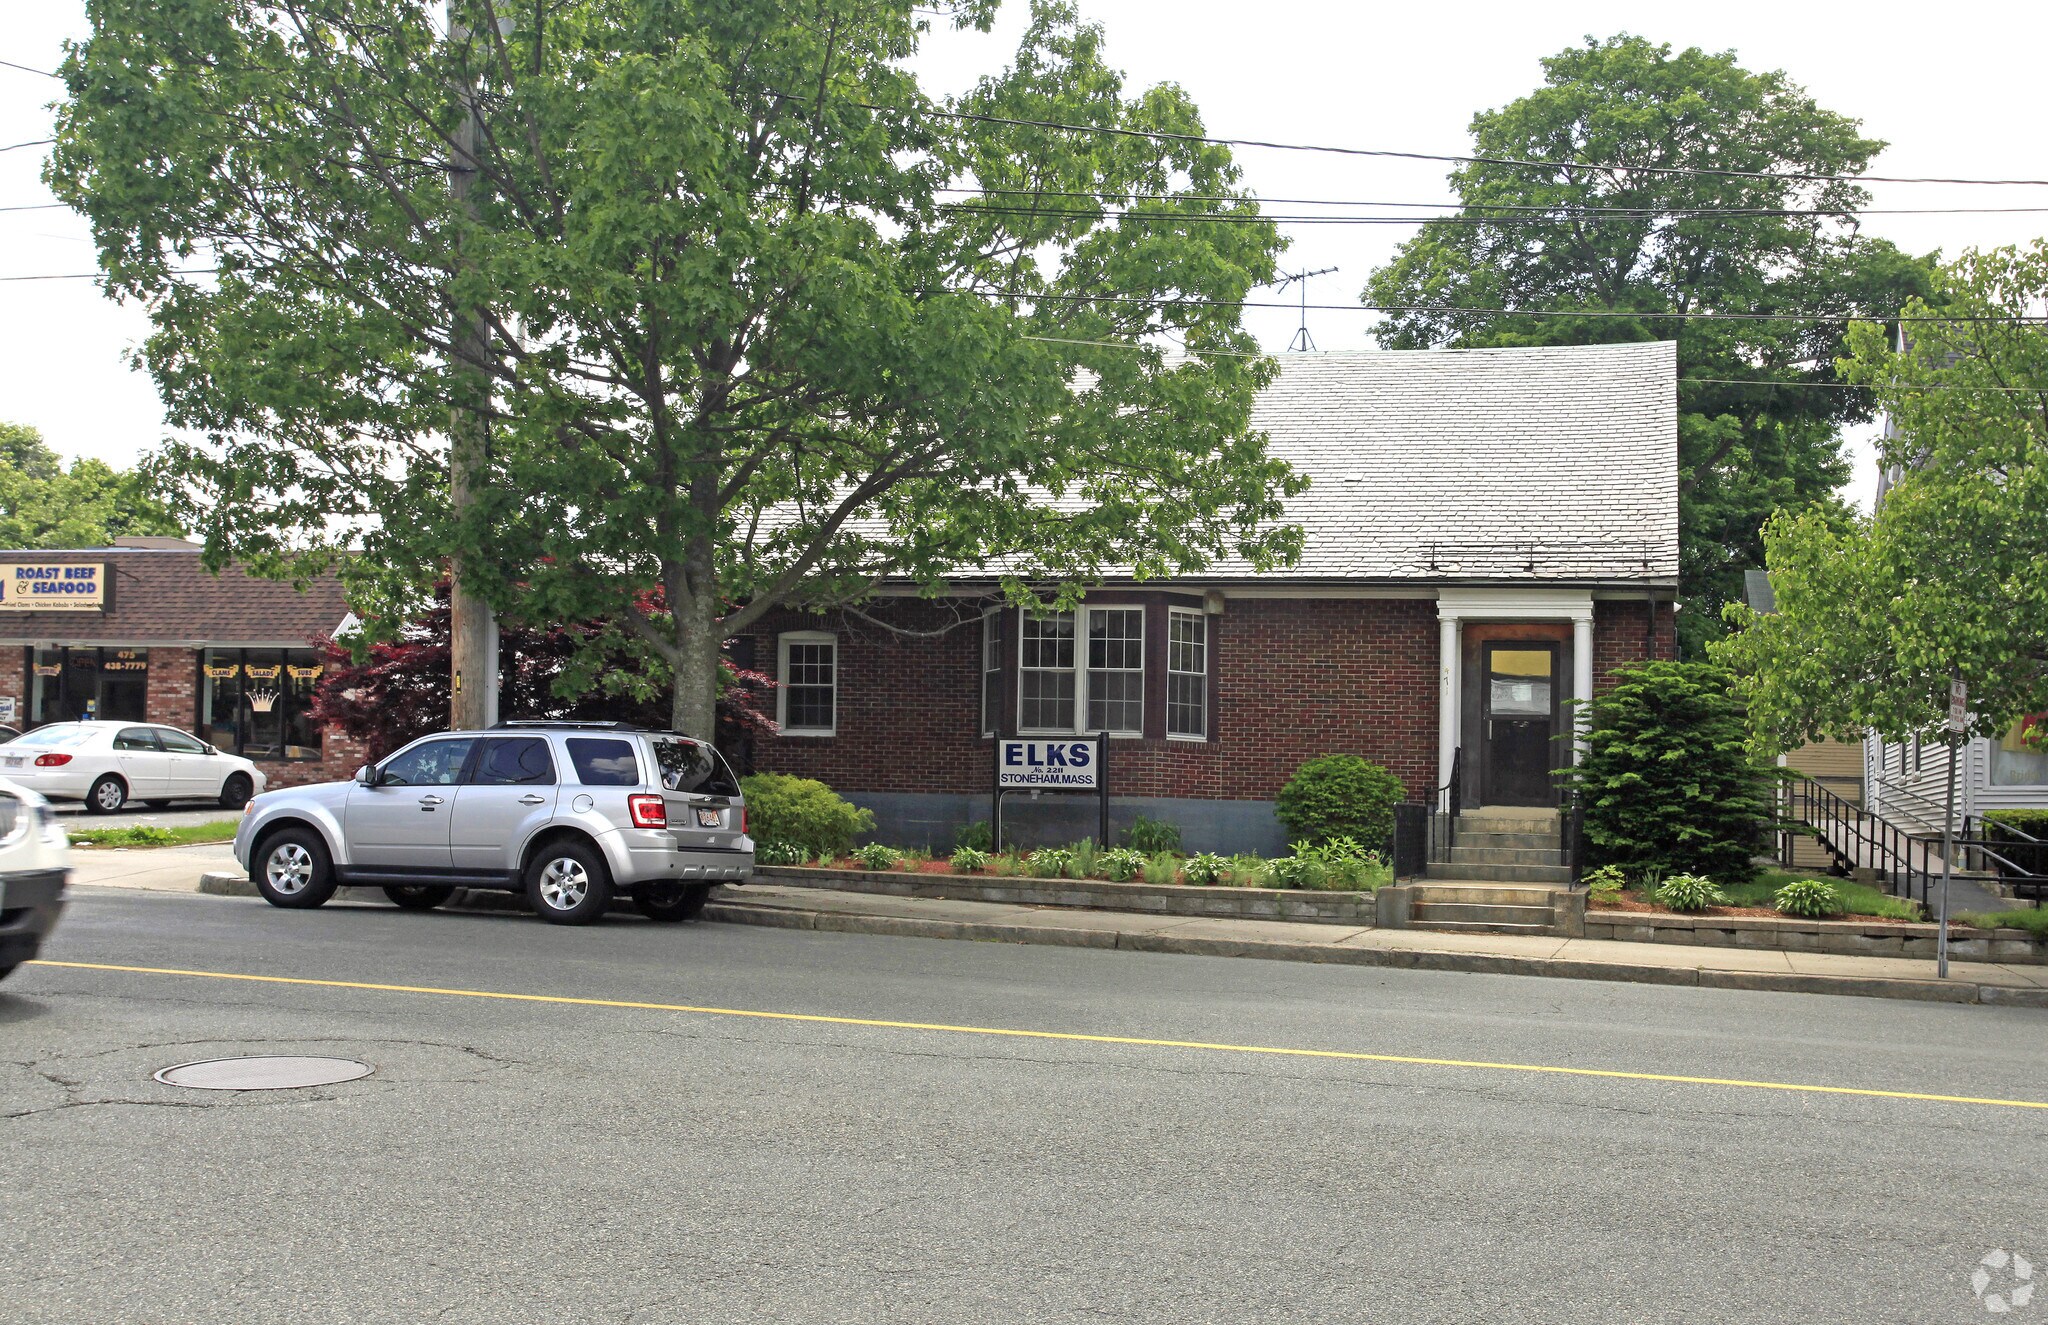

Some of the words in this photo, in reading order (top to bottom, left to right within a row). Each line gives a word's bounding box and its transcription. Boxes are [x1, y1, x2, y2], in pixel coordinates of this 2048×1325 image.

[16, 567, 60, 579] ROAST
[64, 568, 96, 579] BEEF
[16, 580, 29, 594] &
[32, 582, 96, 594] SEAFOOD
[117, 650, 136, 659] 475
[104, 661, 147, 671] 438-7779
[1006, 743, 1090, 767] ELKS
